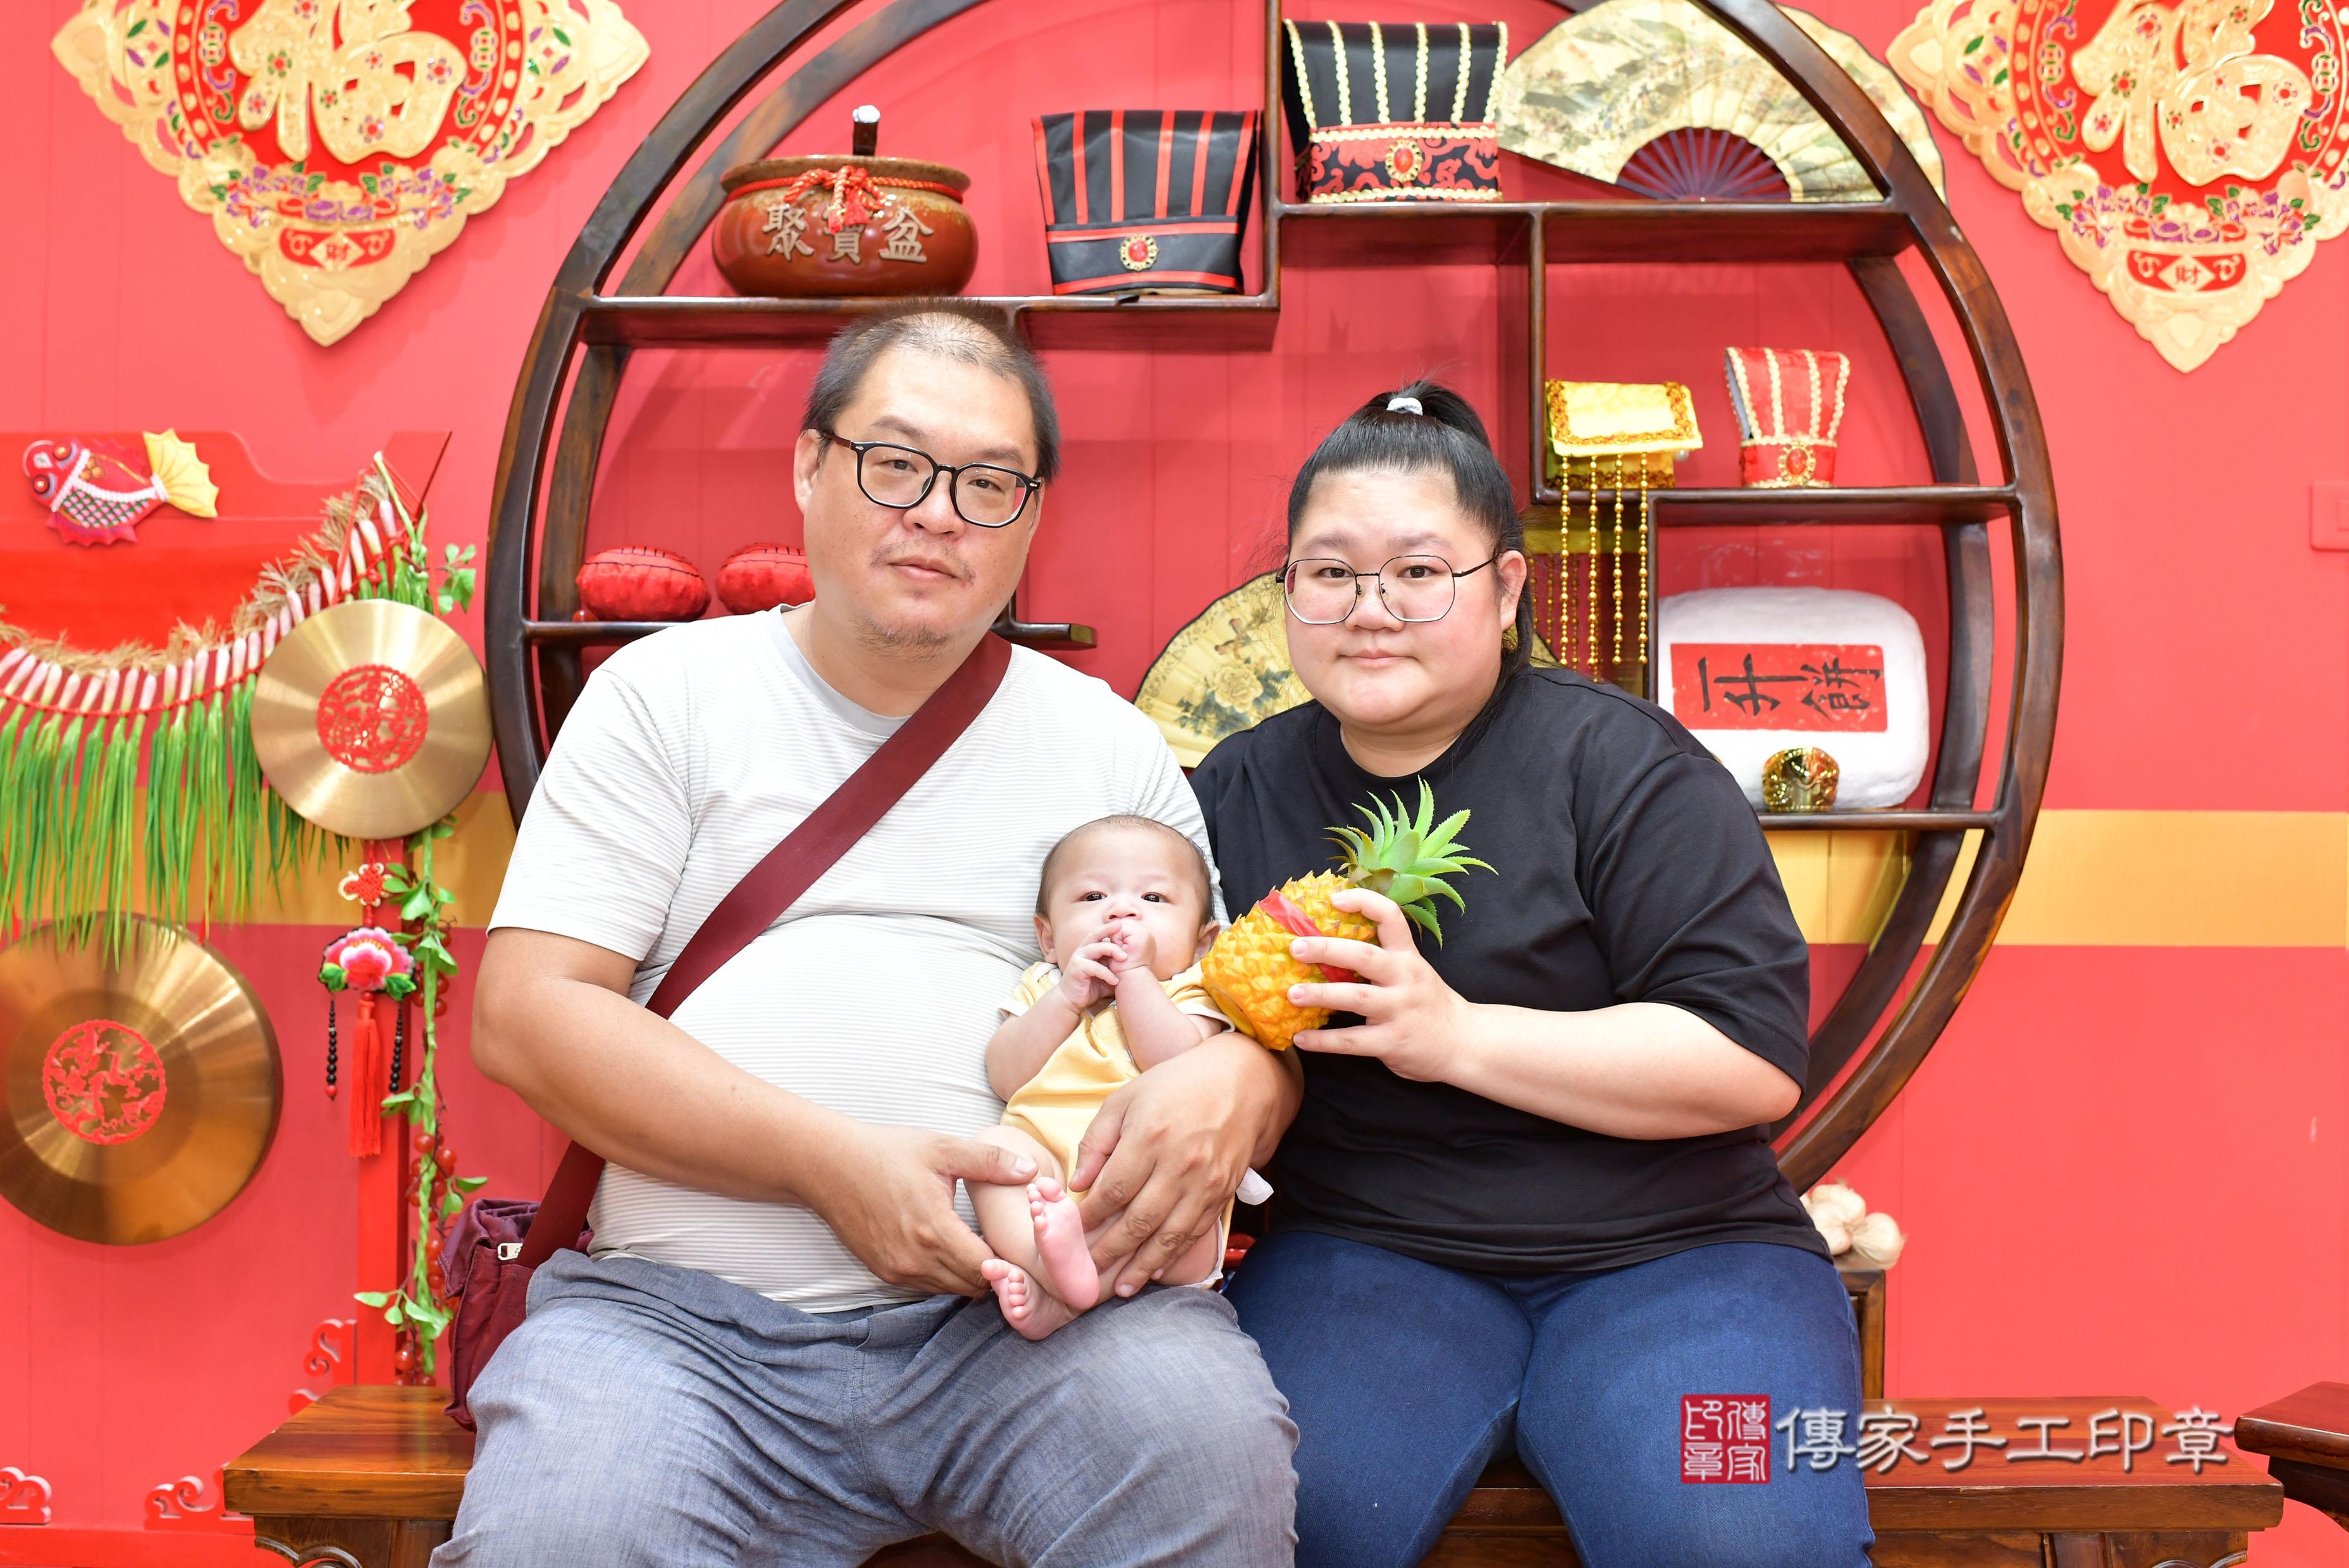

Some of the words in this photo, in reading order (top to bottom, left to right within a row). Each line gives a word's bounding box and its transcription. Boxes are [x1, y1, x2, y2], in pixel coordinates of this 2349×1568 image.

[228, 0, 467, 164] 福
[2073, 0, 2312, 186] 福
[2176, 265, 2200, 285] 財
